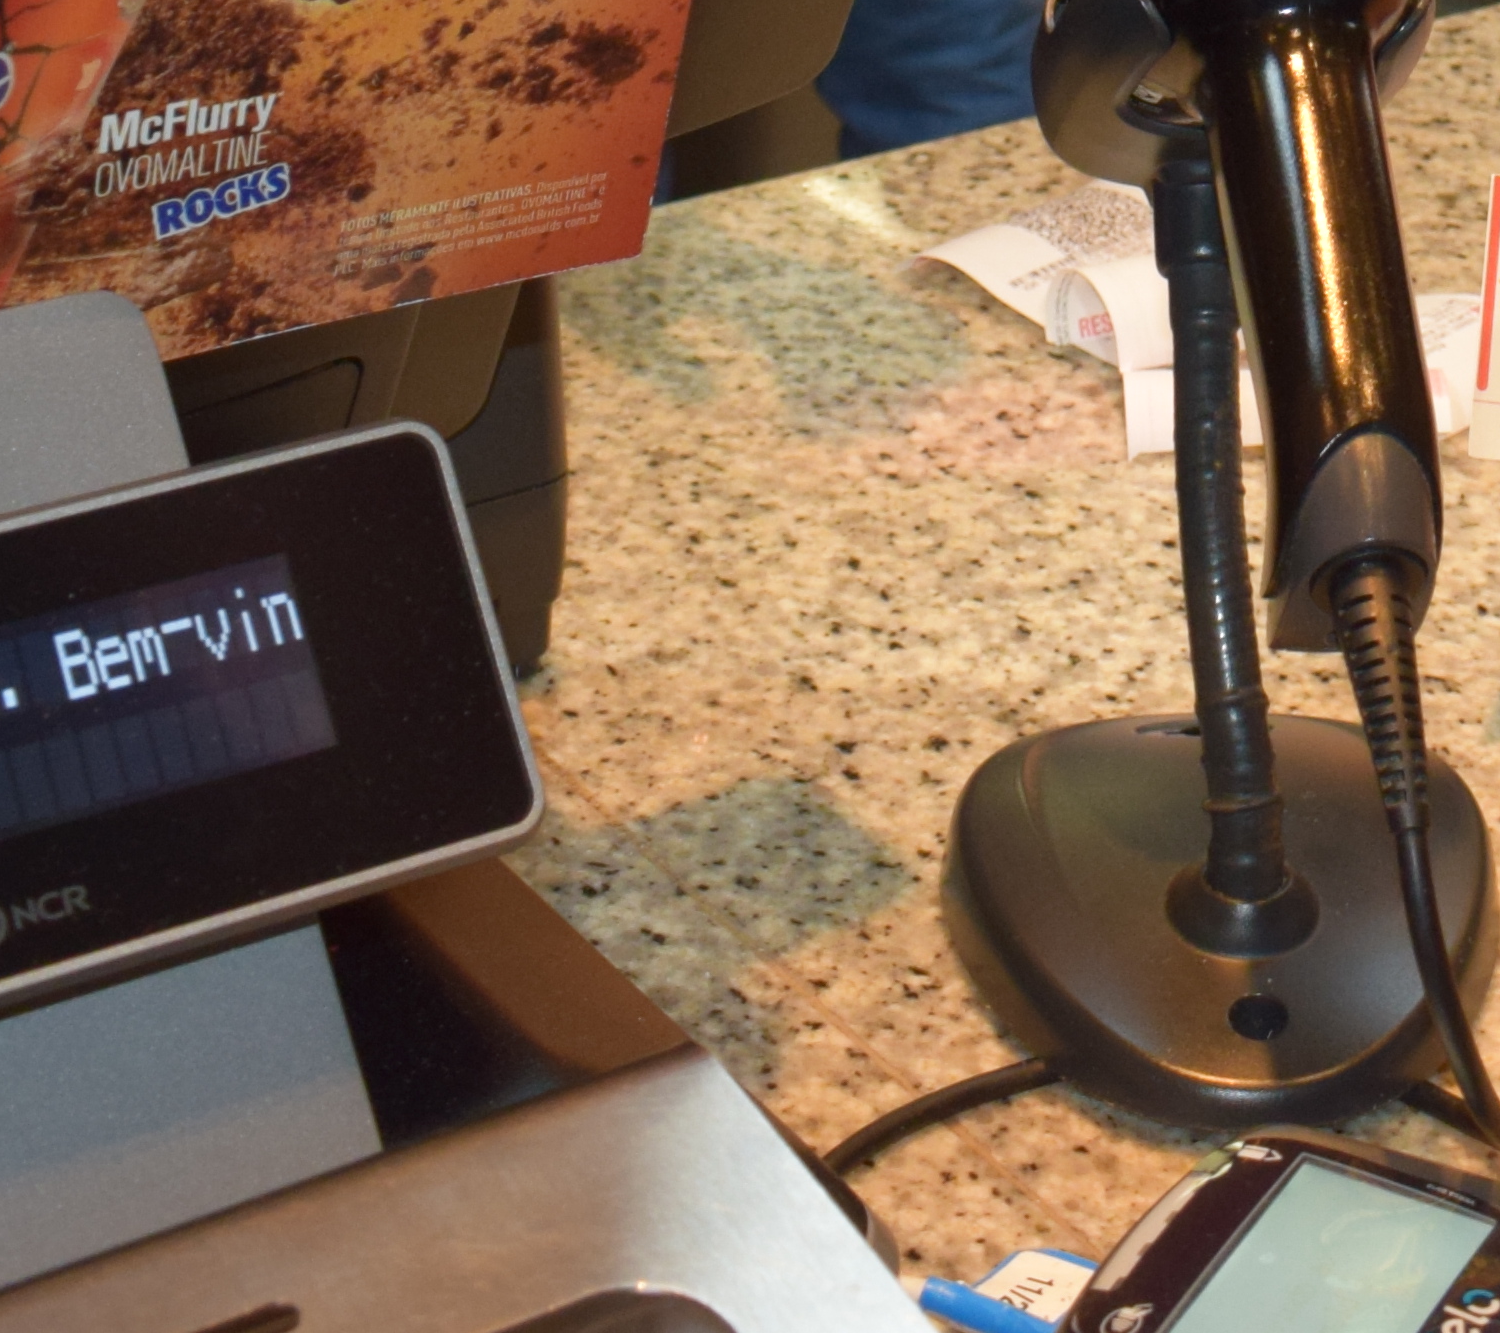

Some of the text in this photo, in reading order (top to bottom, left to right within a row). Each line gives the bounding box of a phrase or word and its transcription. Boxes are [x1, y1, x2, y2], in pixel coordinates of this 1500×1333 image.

[97, 92, 277, 154] McFlurry
[94, 130, 271, 197] OVOMALTINE
[152, 162, 291, 240] ROCKS
[54, 588, 304, 701] Bem-vin
[10, 885, 91, 932] NCR
